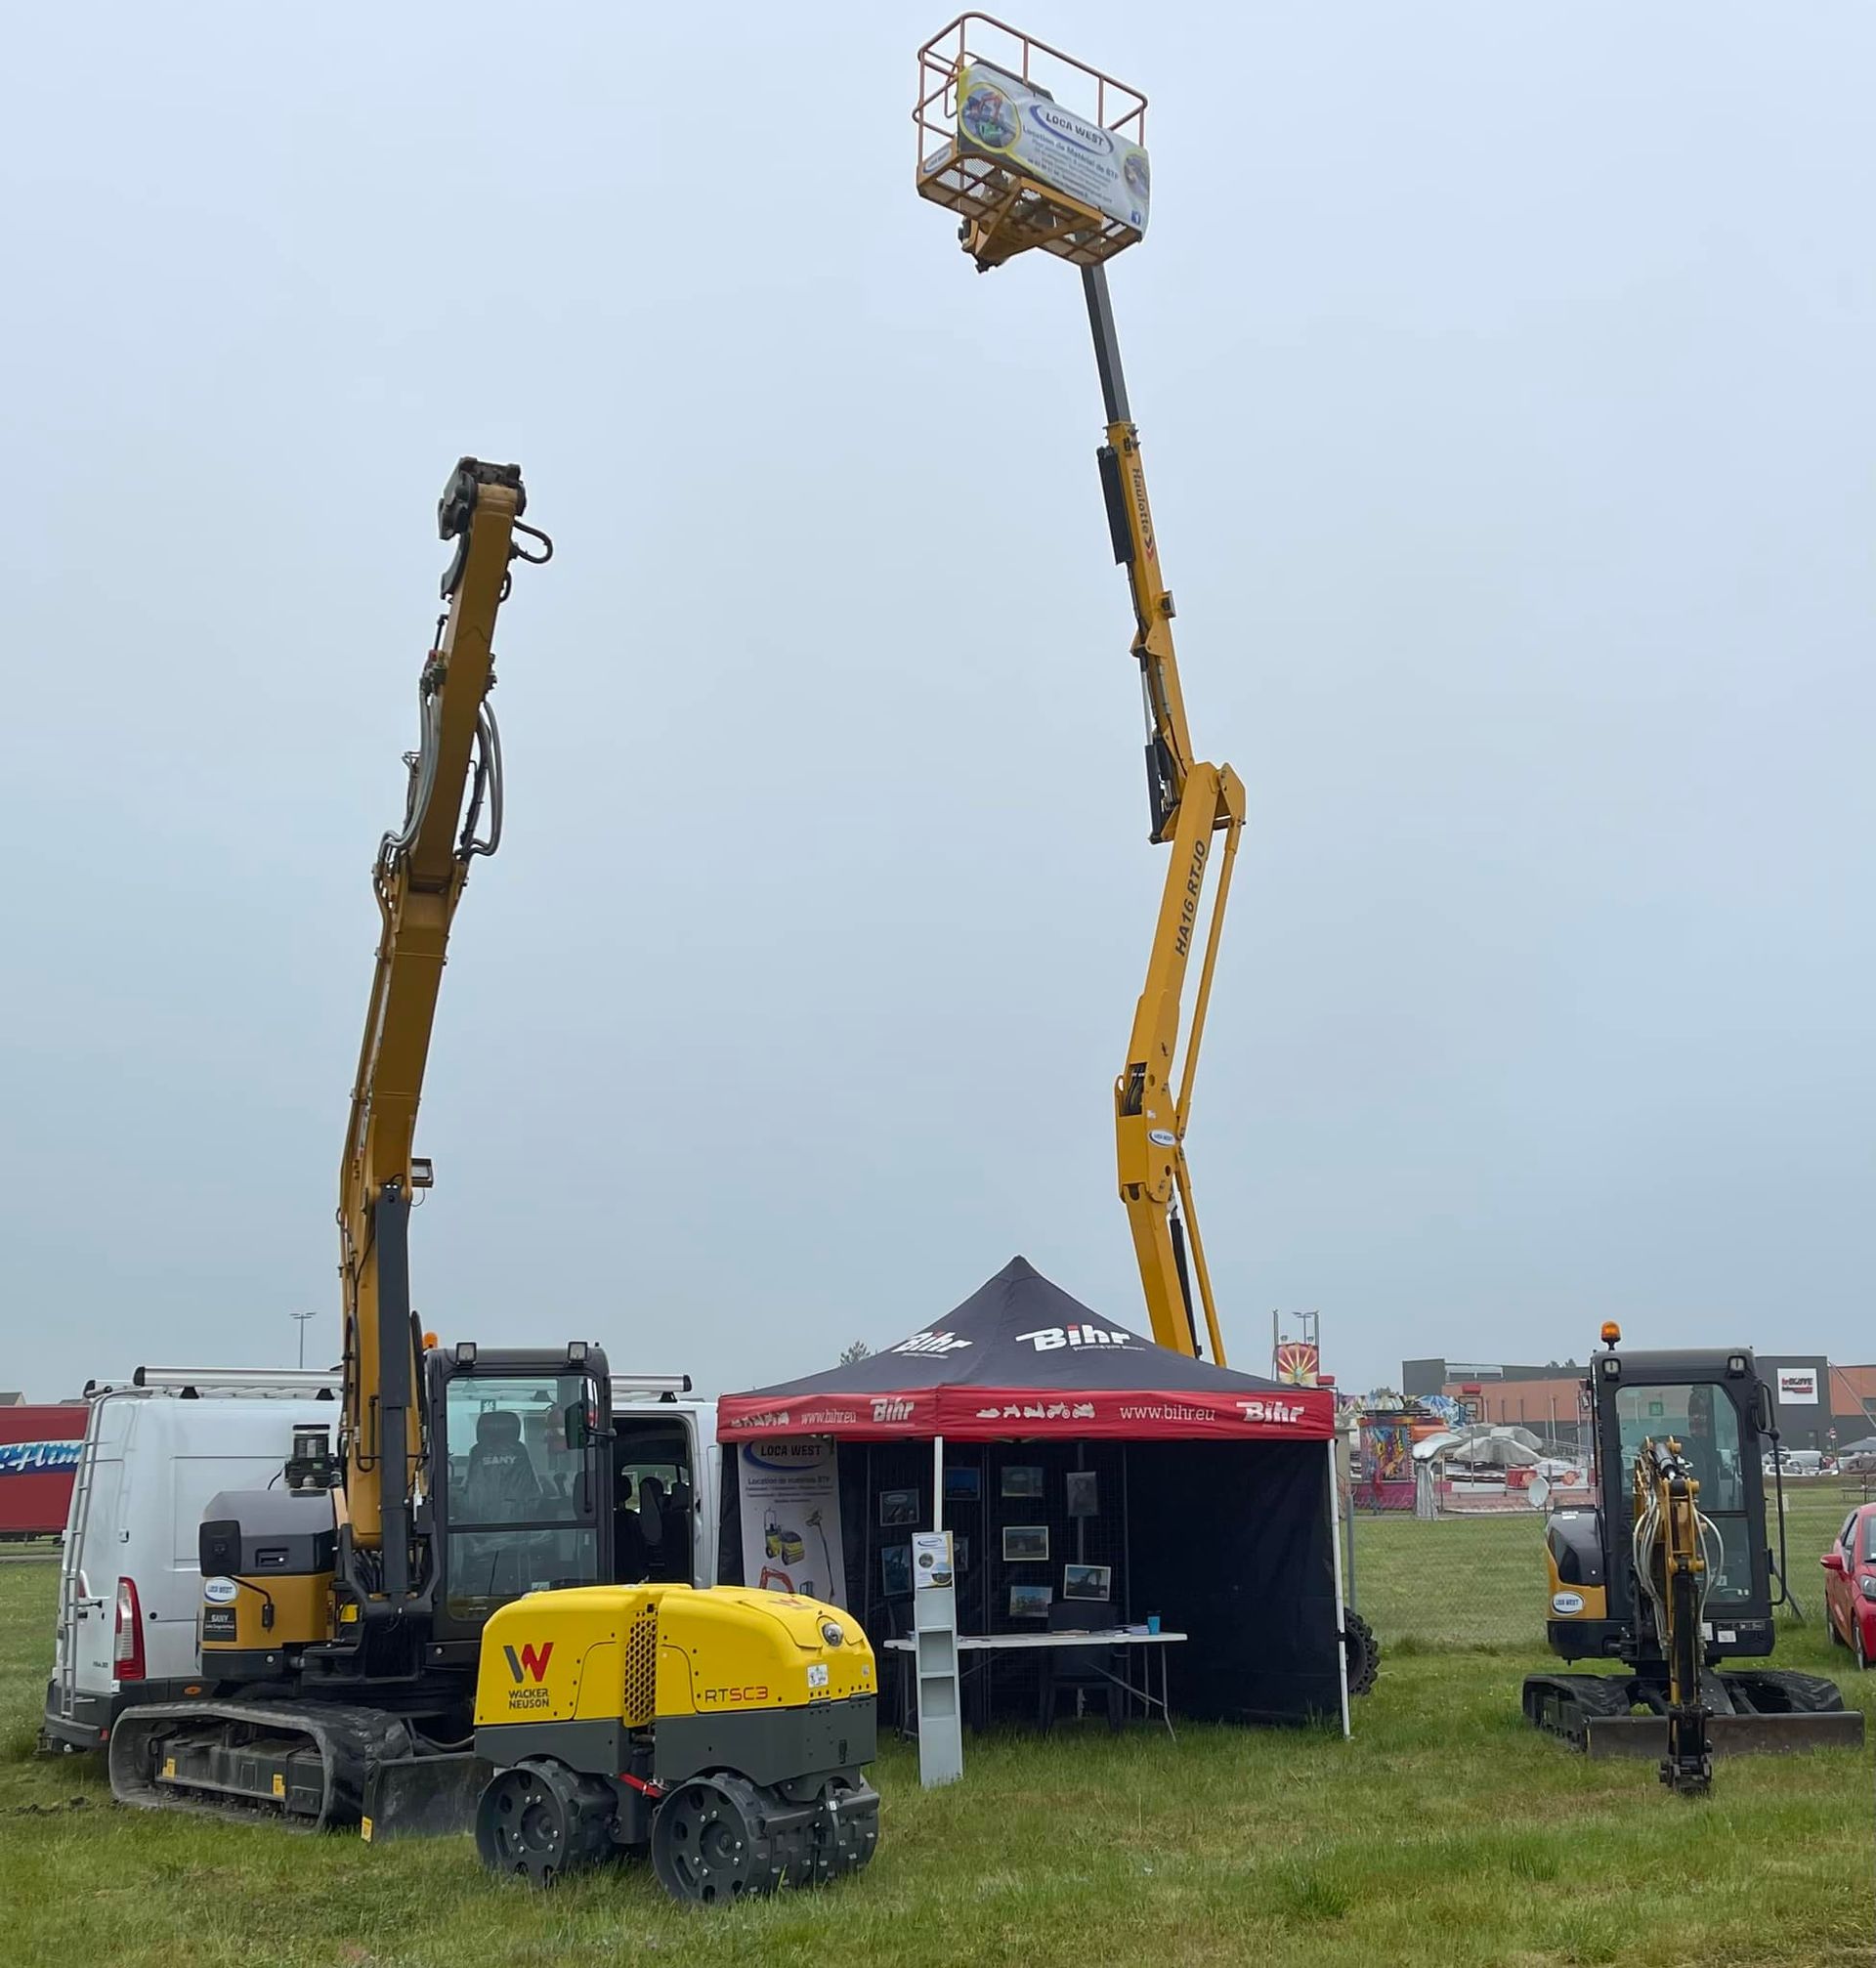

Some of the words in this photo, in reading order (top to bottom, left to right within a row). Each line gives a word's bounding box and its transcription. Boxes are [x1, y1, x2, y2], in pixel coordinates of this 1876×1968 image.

[1045, 112, 1073, 133] LOCA
[1075, 125, 1104, 147] WEST
[1132, 469, 1150, 534] Haulotte
[1175, 898, 1194, 957] HA16
[891, 1329, 973, 1352] Bihr
[1015, 1324, 1130, 1351] Bihr
[870, 1397, 915, 1423] Bihr
[1120, 1403, 1216, 1422] www.bihr.eu
[1236, 1400, 1305, 1423] Bihr
[482, 1455, 518, 1466] SANY
[760, 1445, 788, 1456] LOCA
[790, 1445, 822, 1456] WEST
[508, 1689, 549, 1698] WACKER
[509, 1698, 549, 1709] NEUSON
[704, 1686, 768, 1703] RTSC3
